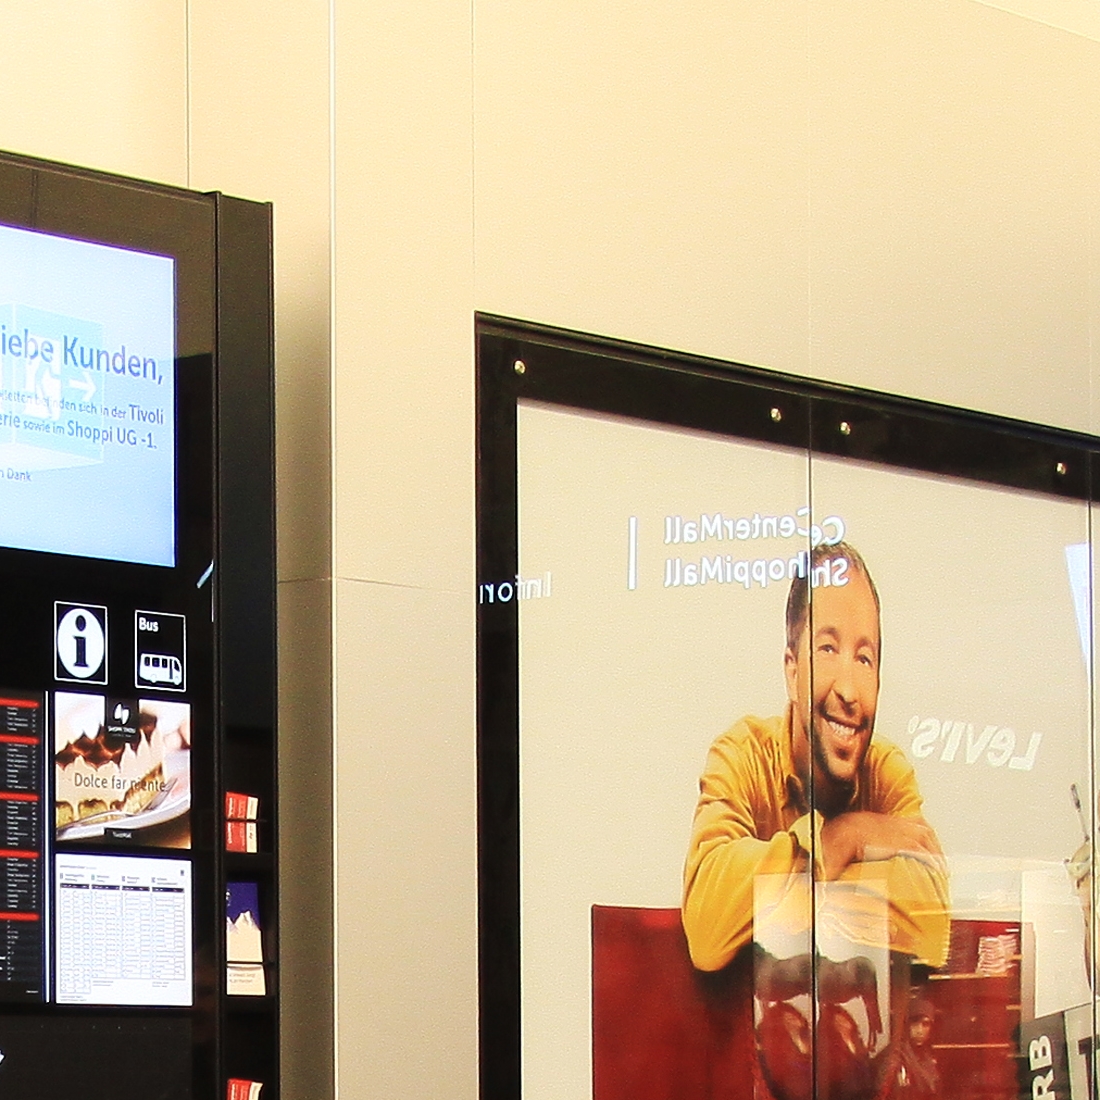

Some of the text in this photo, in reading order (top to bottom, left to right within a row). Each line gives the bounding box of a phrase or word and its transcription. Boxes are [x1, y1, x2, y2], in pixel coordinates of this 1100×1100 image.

[62, 334, 164, 386] Kunden,
[111, 404, 127, 419] der
[128, 402, 165, 426] Tivoli
[23, 419, 51, 434] sowie
[52, 422, 65, 435] im
[67, 419, 113, 446] Shoppi
[116, 427, 138, 446] UG
[140, 431, 158, 450] -1.
[6, 466, 32, 482] Dank
[138, 616, 160, 634] Bus
[73, 772, 166, 793] Dolce far niente
